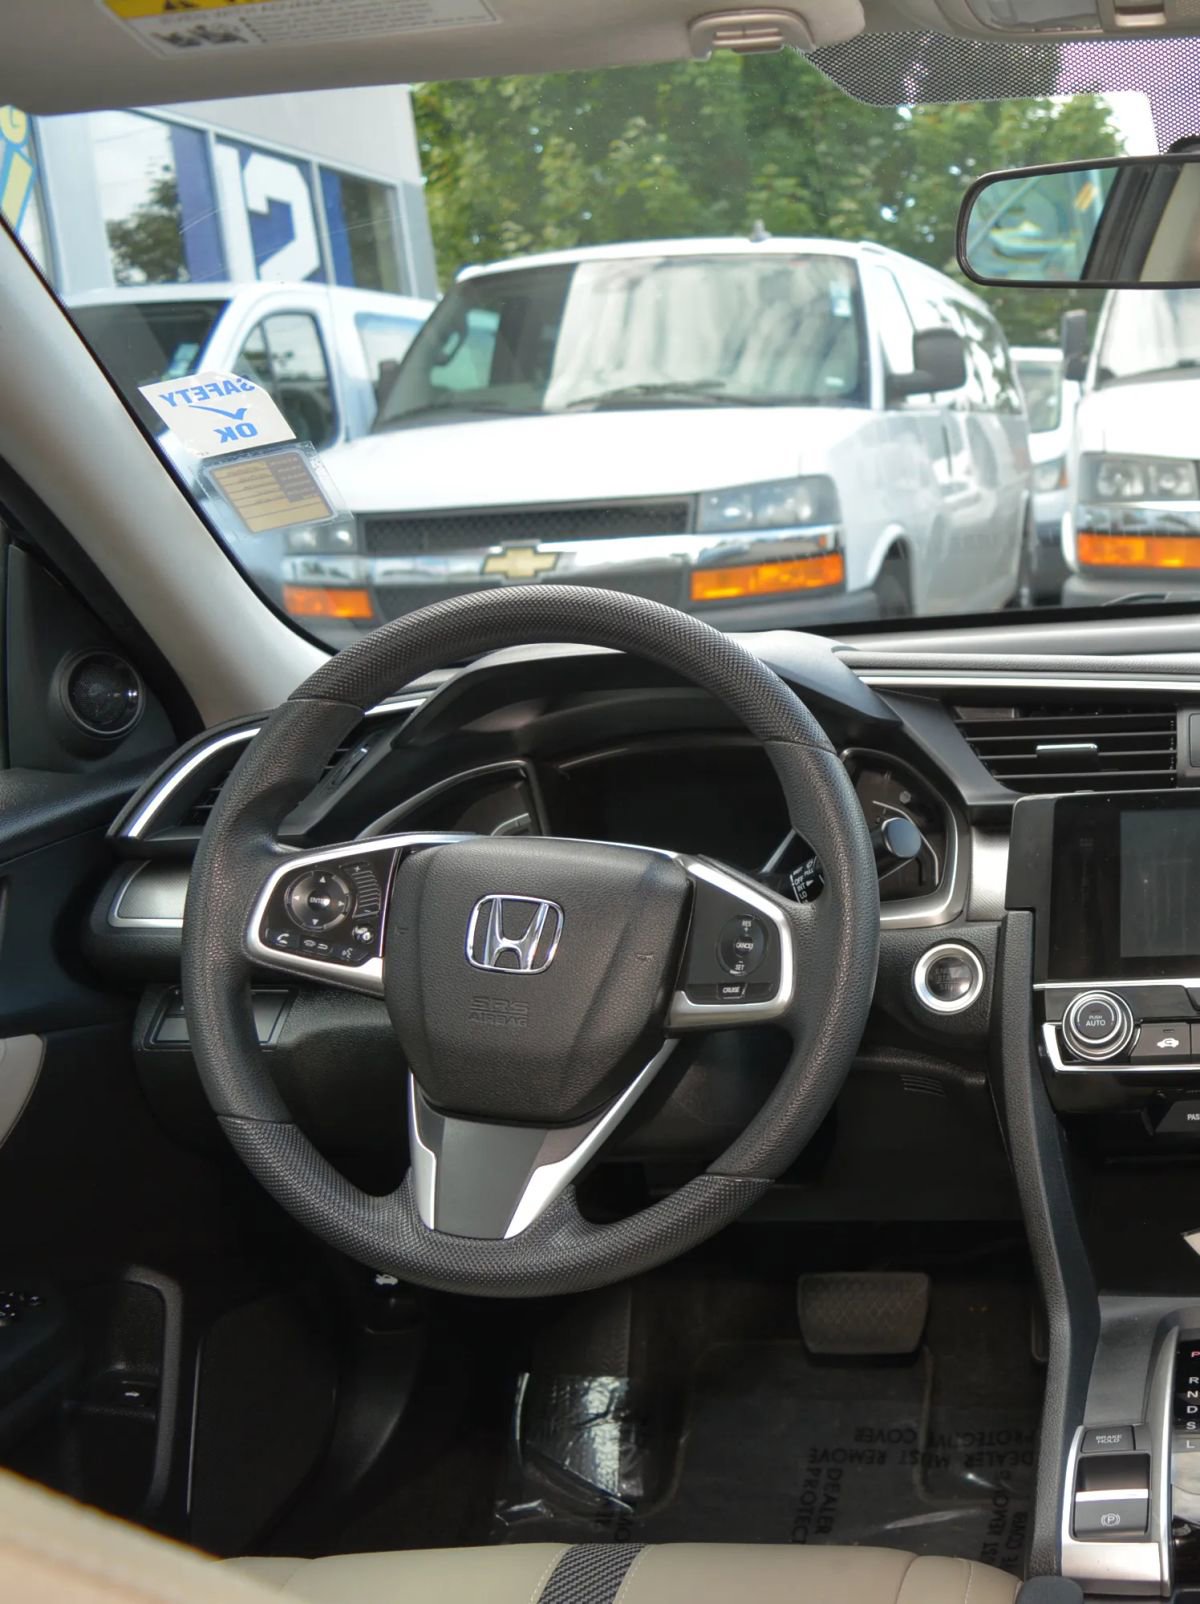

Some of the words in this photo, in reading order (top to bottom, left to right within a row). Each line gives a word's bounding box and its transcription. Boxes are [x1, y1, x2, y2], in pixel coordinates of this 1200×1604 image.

[1085, 1019, 1106, 1027] AUTO
[1188, 1376, 1200, 1384] R
[1187, 1390, 1199, 1398] N
[1186, 1405, 1199, 1414] D
[1186, 1421, 1197, 1430] S
[855, 1427, 918, 1443] COVER
[1186, 1440, 1196, 1449] L
[808, 1447, 888, 1464] REMOVE
[965, 1451, 1034, 1468] DEALER
[814, 1467, 844, 1535] DEALER
